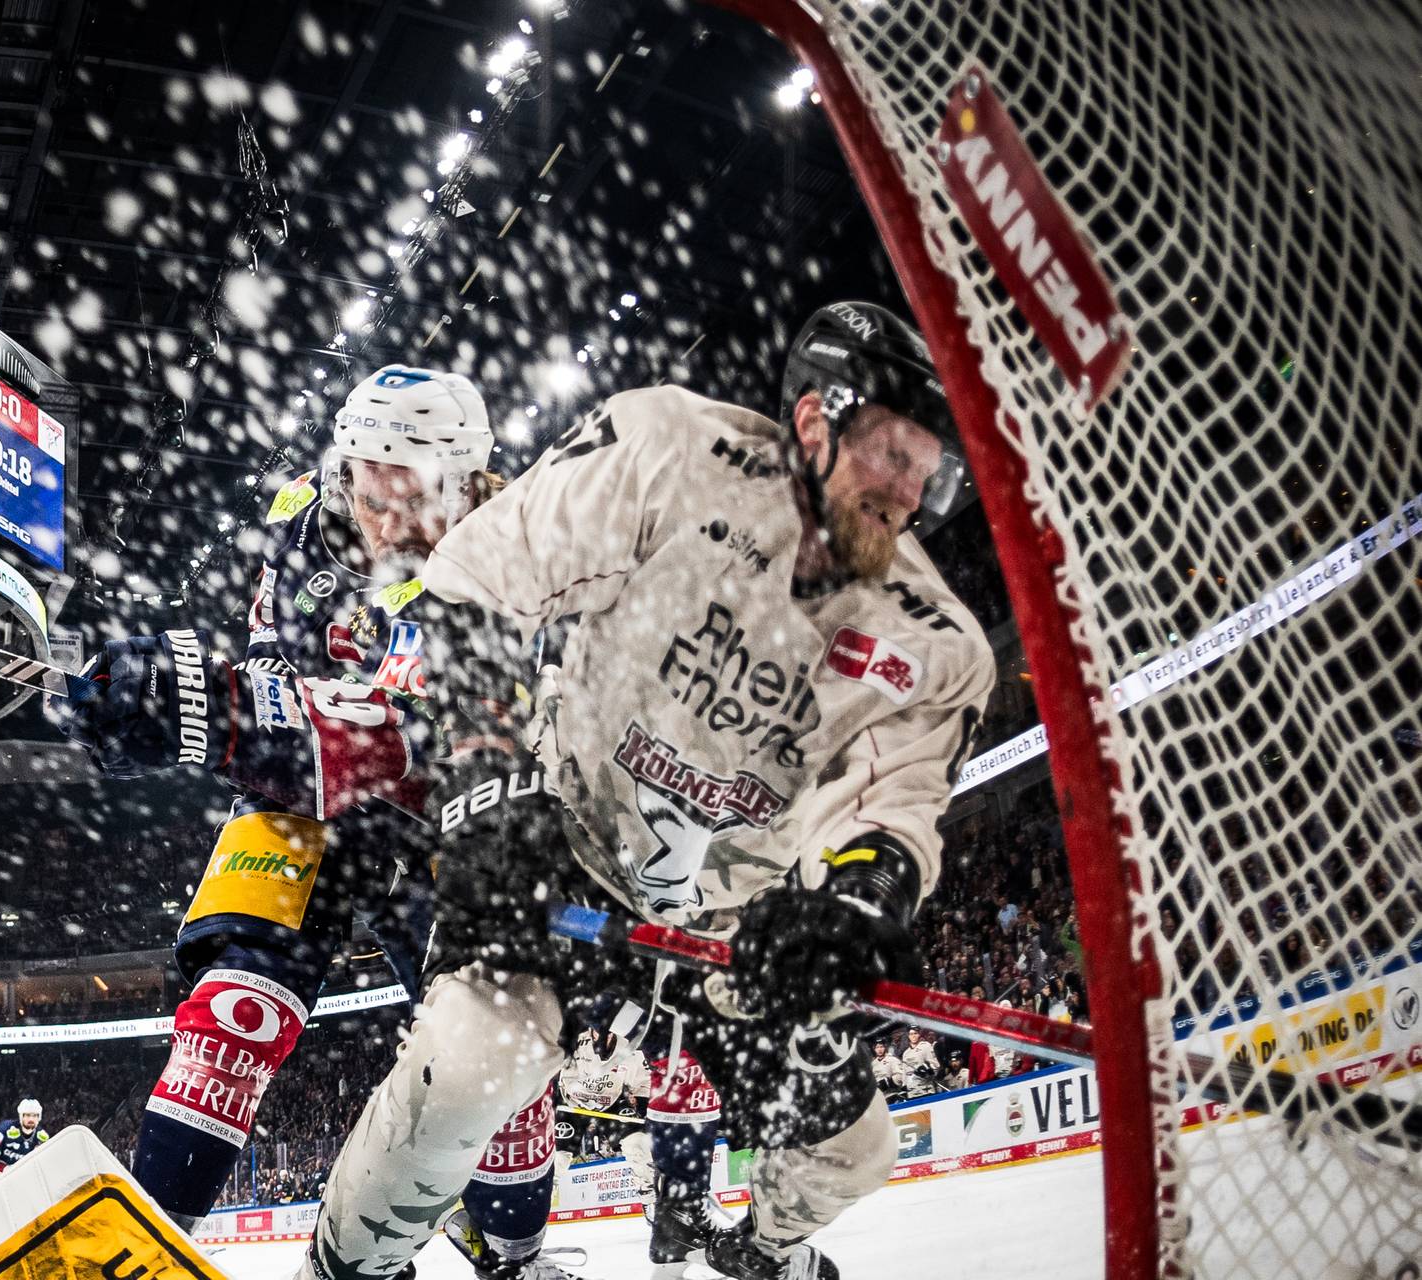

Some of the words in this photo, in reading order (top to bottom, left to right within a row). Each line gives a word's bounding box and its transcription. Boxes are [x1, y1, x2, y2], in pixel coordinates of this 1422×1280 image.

[955, 135, 1108, 366] PENNY
[165, 629, 208, 765] WARRIOR
[253, 978, 271, 992] 2011
[184, 1111, 229, 1138] DEUTSCHER
